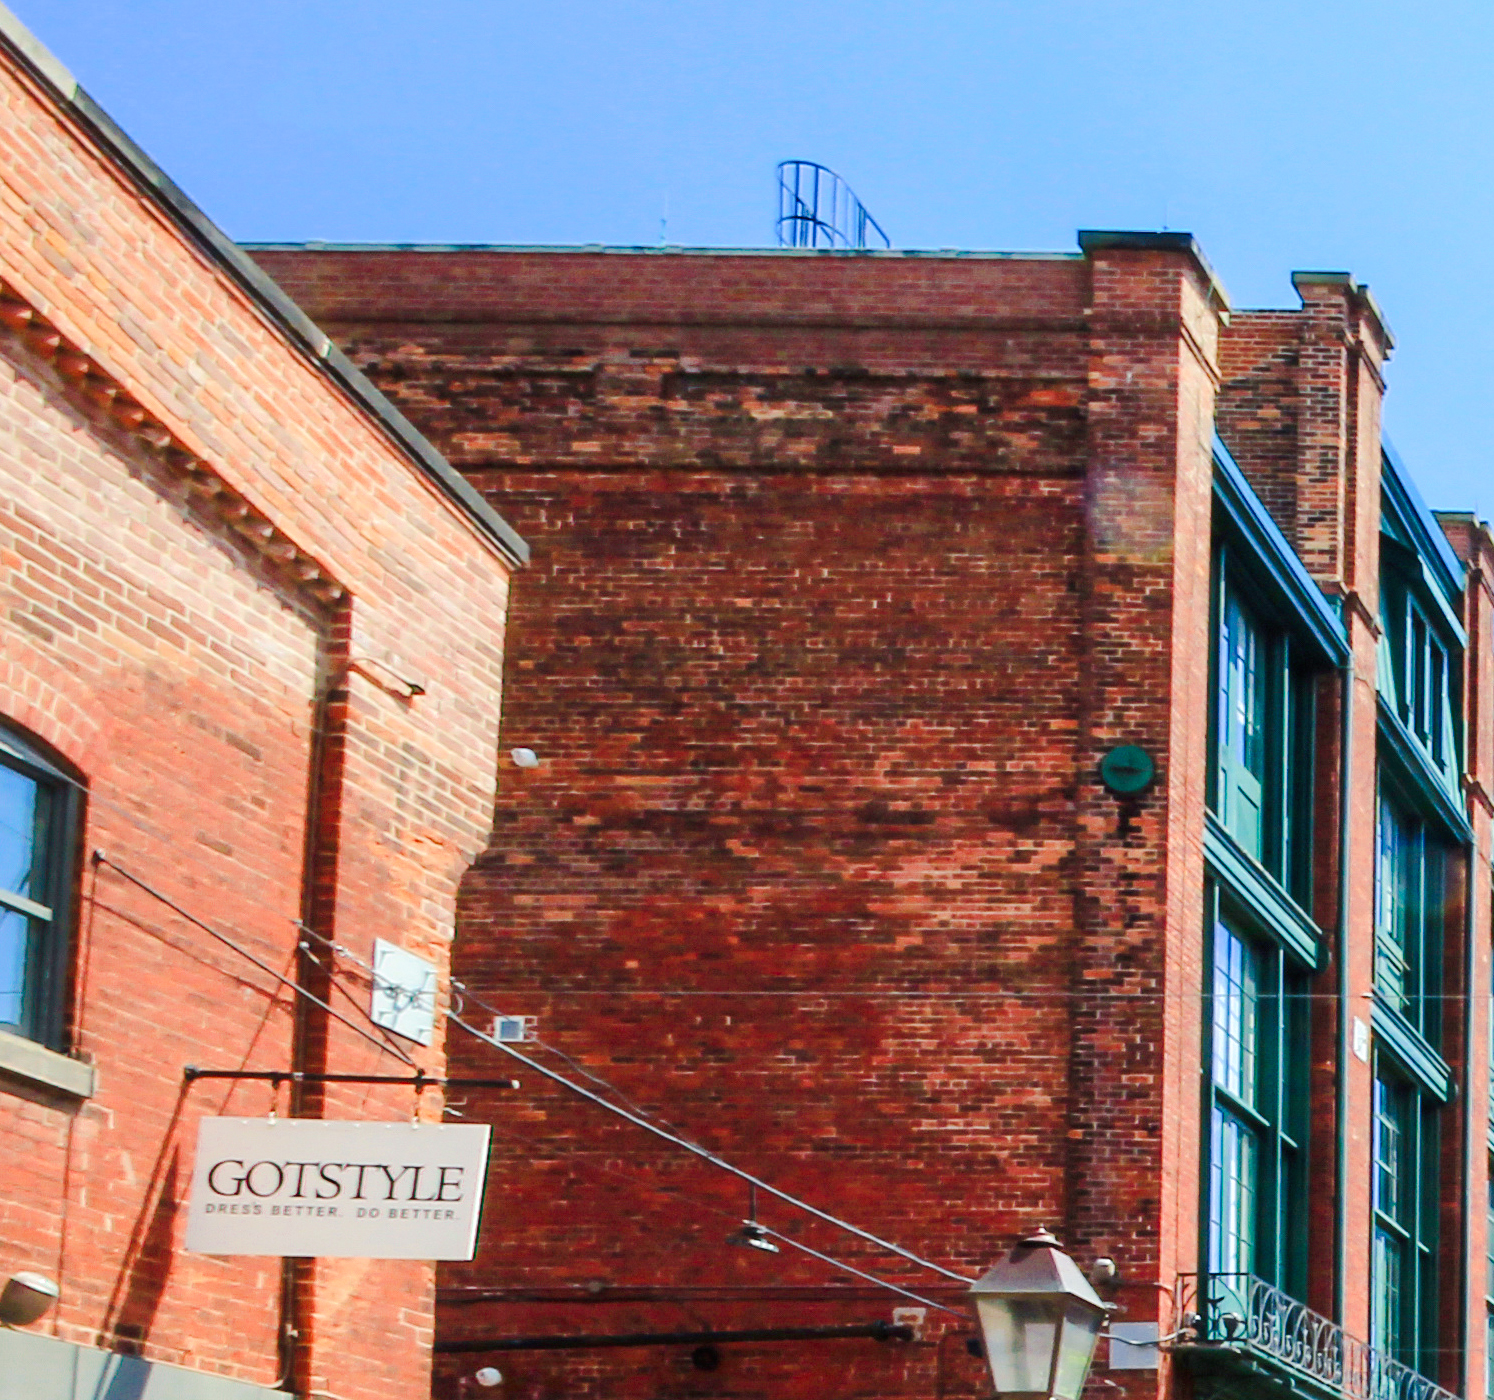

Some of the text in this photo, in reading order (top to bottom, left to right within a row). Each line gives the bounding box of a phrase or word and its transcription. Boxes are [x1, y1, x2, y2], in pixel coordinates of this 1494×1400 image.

[208, 1160, 465, 1202] GOTSTYLE
[205, 1203, 262, 1216] DRESS
[356, 1207, 380, 1219] DO
